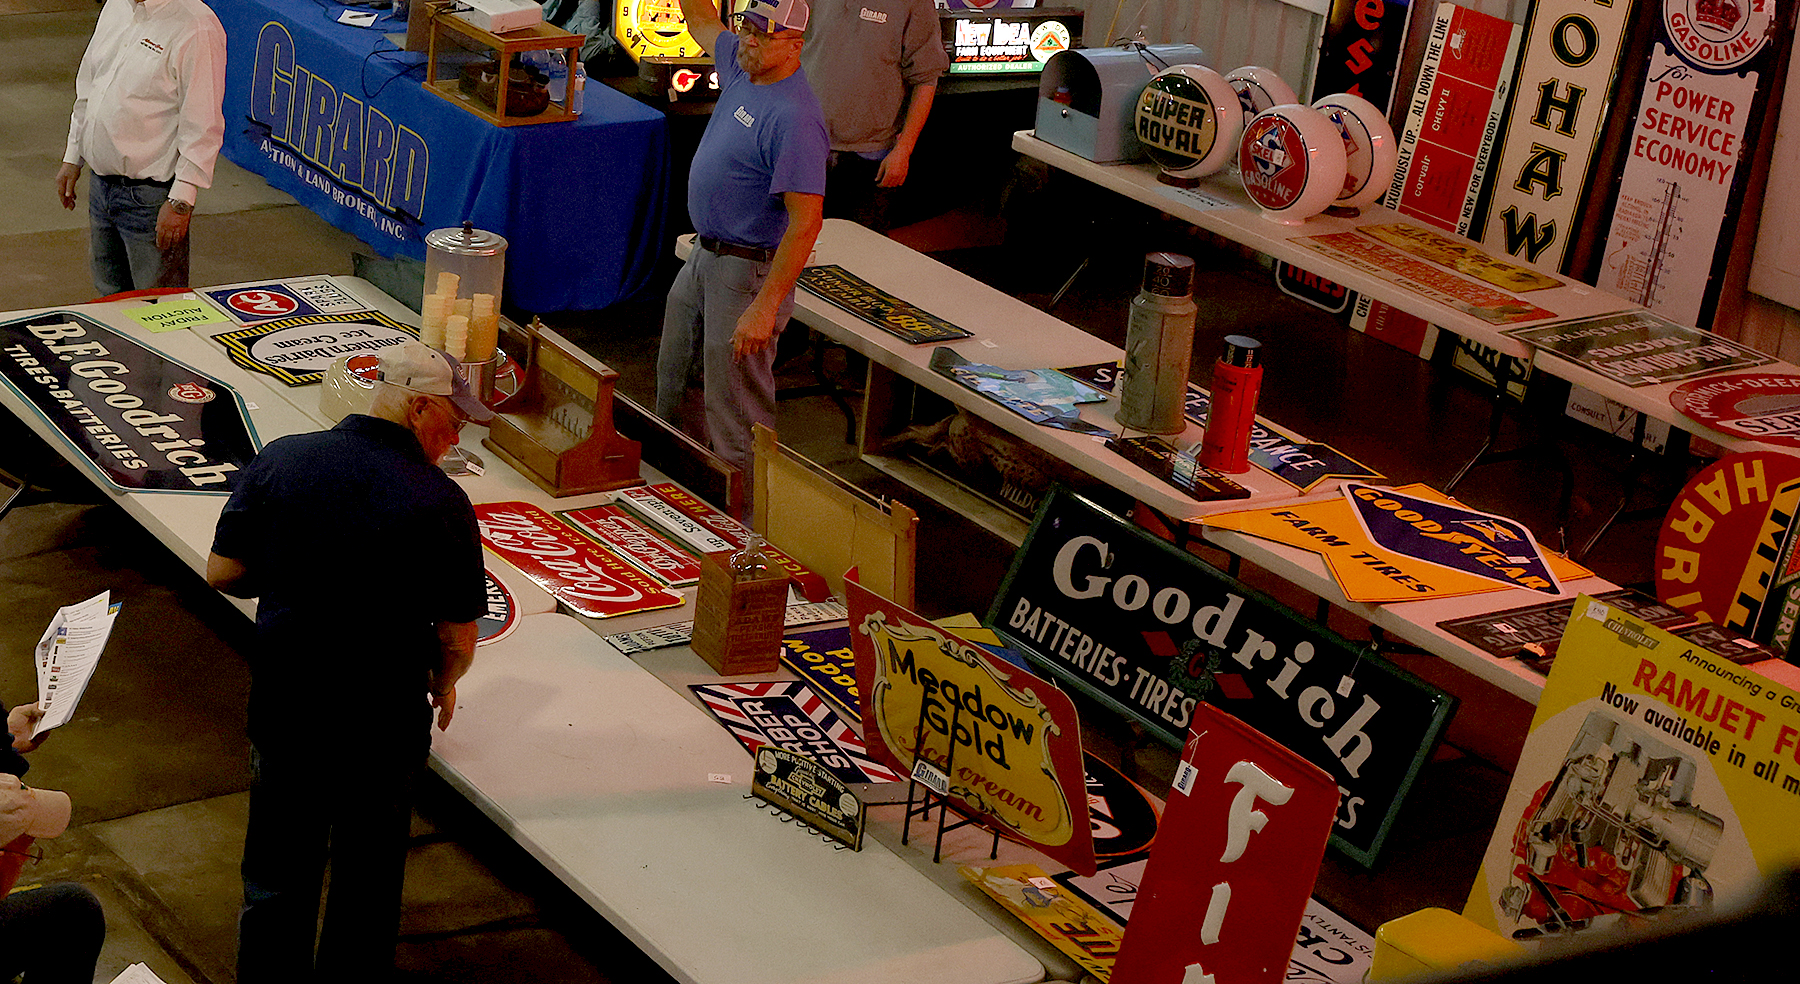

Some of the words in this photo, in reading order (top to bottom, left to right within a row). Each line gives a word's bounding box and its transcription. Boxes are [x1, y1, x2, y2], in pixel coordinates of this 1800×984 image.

[859, 7, 888, 24] GIRARD
[954, 20, 993, 47] NEW
[994, 18, 1032, 47] IDEA
[1670, 11, 1759, 63] GASOLINE
[955, 46, 979, 57] FARM
[979, 44, 1030, 57] EQUIPMENT
[956, 62, 1000, 73] AUTHORIZED
[1001, 61, 1034, 72] DEALER
[1417, 65, 1435, 99] DOWN
[1427, 38, 1442, 64] THE
[1435, 14, 1451, 41] LINE
[1648, 63, 1694, 84] for
[250, 20, 431, 222] GIRARD
[1138, 87, 1206, 125] SUPER
[1431, 96, 1447, 133] CHEVY
[1654, 80, 1736, 125] POWER
[1137, 118, 1205, 157] ROYAL
[1641, 107, 1737, 157] SERVICE
[1461, 194, 1476, 219] NEW
[1476, 110, 1499, 174] EVERYBODY!
[1633, 135, 1733, 186] ECONOMY
[305, 169, 331, 195] LAND
[379, 216, 406, 242] INC.
[1243, 169, 1295, 206] GASOLINE
[140, 304, 204, 324] AUCTION
[157, 312, 211, 332] FRIDAY
[55, 389, 150, 472] BATTERIES
[524, 508, 558, 530] Cold
[658, 482, 711, 513] HERE
[588, 546, 624, 576] Here
[1270, 509, 1351, 549] FARM
[1350, 548, 1438, 596] TIRES
[624, 572, 660, 597] Sold
[1050, 531, 1382, 782] Goodrich
[1605, 618, 1658, 649] CHEVROLET
[1008, 595, 1124, 687] BATTERIES
[1127, 665, 1197, 731] TIRES
[1679, 647, 1762, 697] Announcing
[887, 635, 1037, 745] Meadow
[1632, 657, 1767, 741] RAMJET
[782, 713, 851, 769] SHOP
[924, 703, 1013, 773] Gold
[1599, 680, 1639, 716] Now
[1643, 706, 1722, 756] available
[1728, 744, 1747, 770] in
[1753, 759, 1777, 785] all
[769, 774, 810, 800] BATTERY
[808, 790, 844, 820] CABLES
[956, 768, 1046, 824] cream
